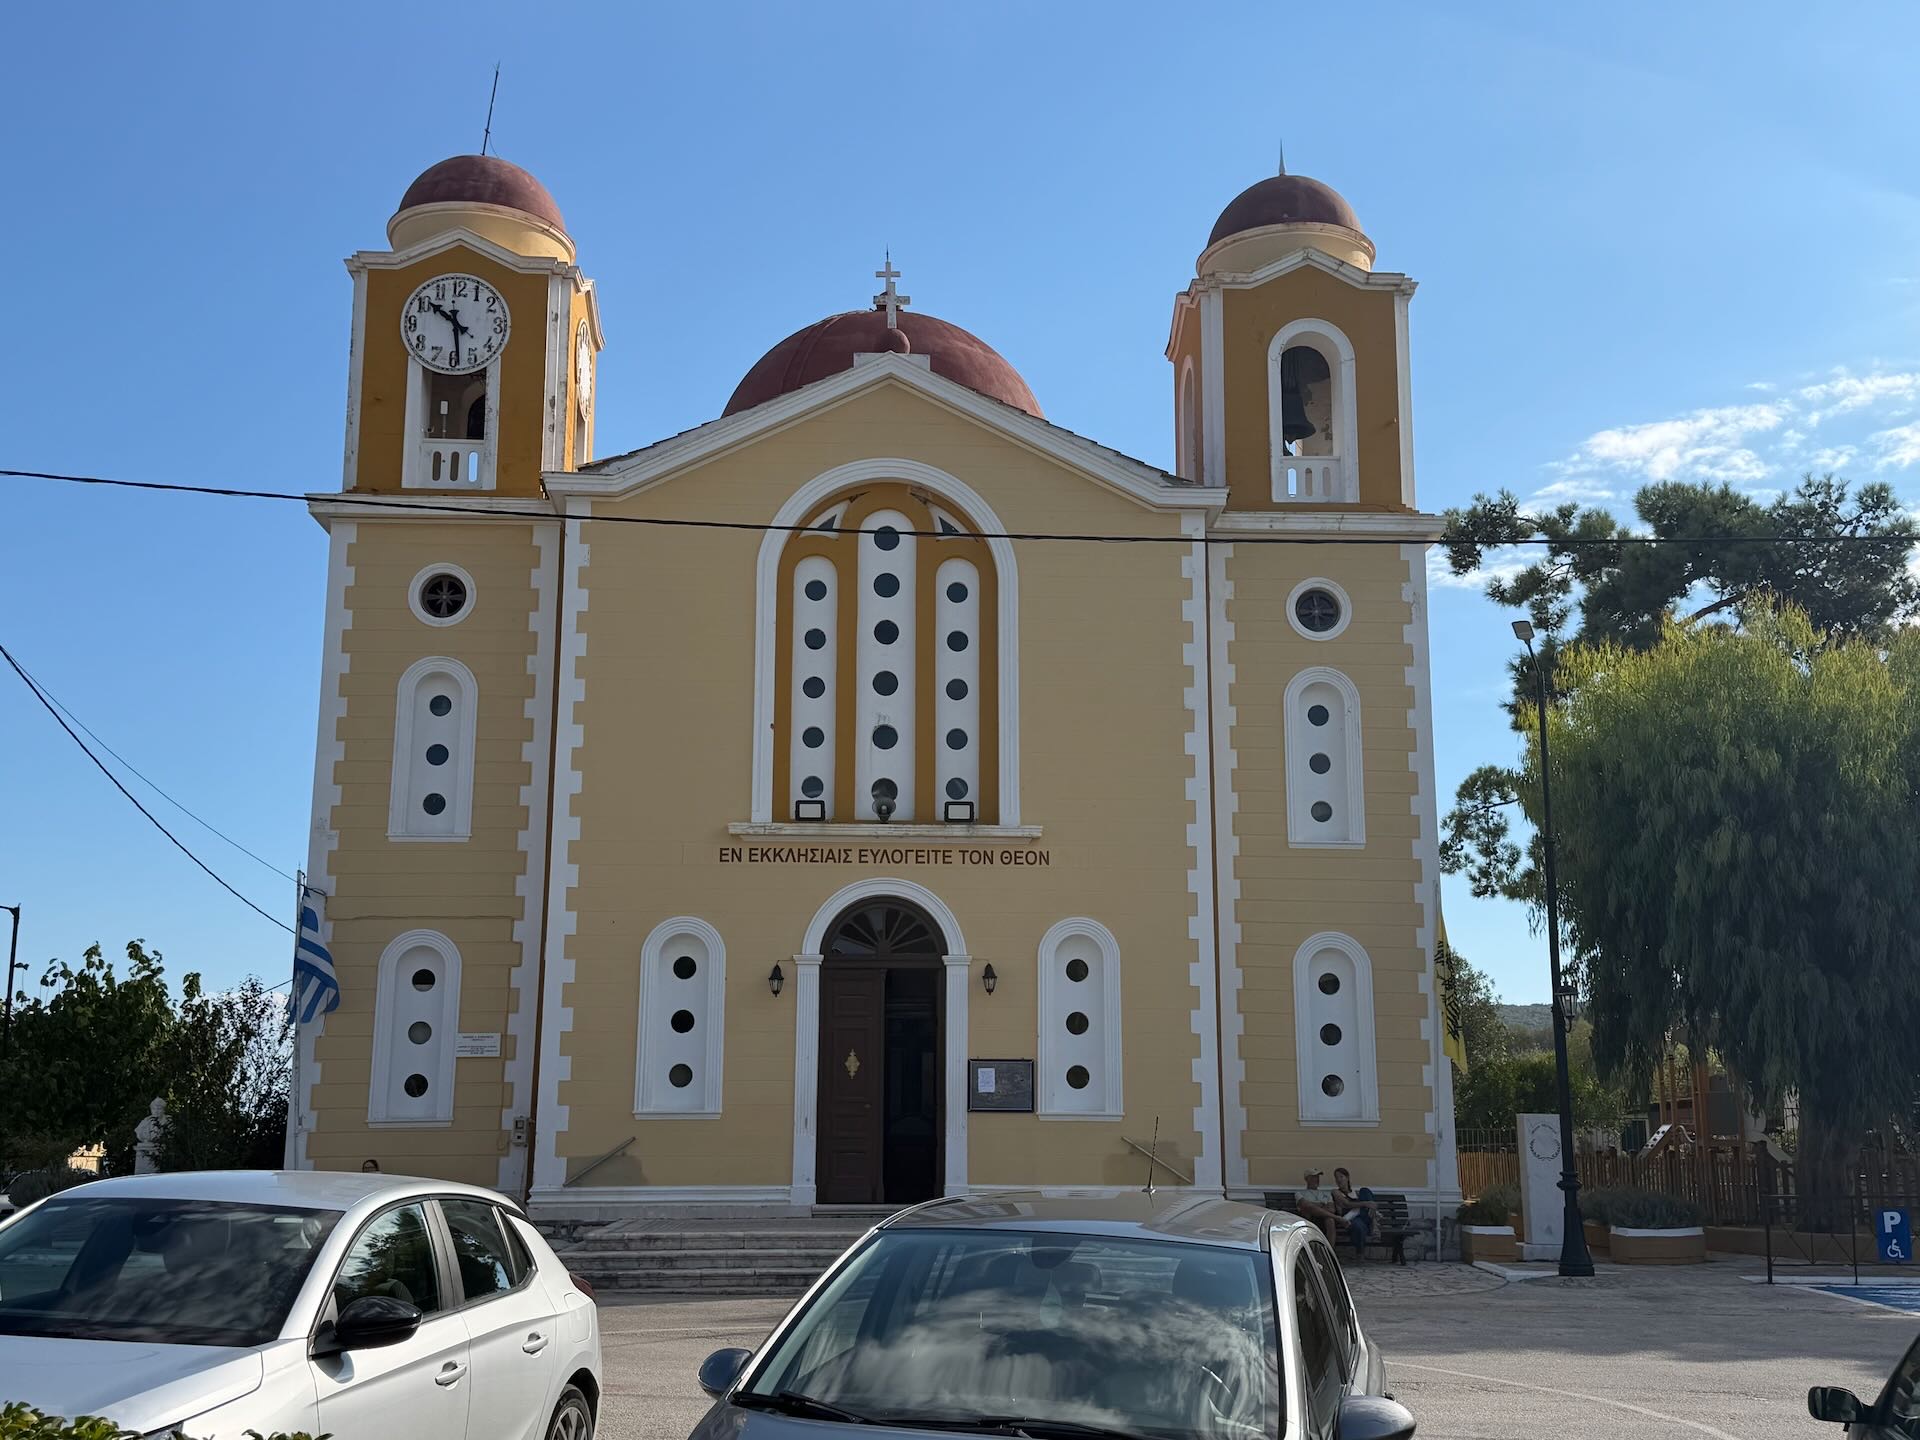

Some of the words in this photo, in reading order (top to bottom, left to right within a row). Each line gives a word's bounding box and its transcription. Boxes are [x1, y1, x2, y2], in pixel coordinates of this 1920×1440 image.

[436, 283, 446, 301] 11
[453, 280, 468, 298] 12
[473, 284, 480, 302] 1
[417, 295, 431, 313] 10
[486, 296, 496, 314] 2
[408, 315, 417, 332] 9
[493, 317, 503, 334] 3
[415, 334, 426, 351] 8
[483, 336, 494, 353] 4
[431, 346, 443, 362] 7
[448, 350, 457, 368] 6
[467, 347, 478, 365] 5
[719, 847, 743, 863] ΕΝ
[748, 847, 853, 864] ΕΚΚΛΗΣΙΑΙΣ
[858, 848, 953, 865] ΕΥΛΟΓΕΙΤΕ
[958, 849, 995, 865] ΤΟΝ
[999, 849, 1050, 866] ΘΕΟΝ
[1883, 1211, 1902, 1233] P
